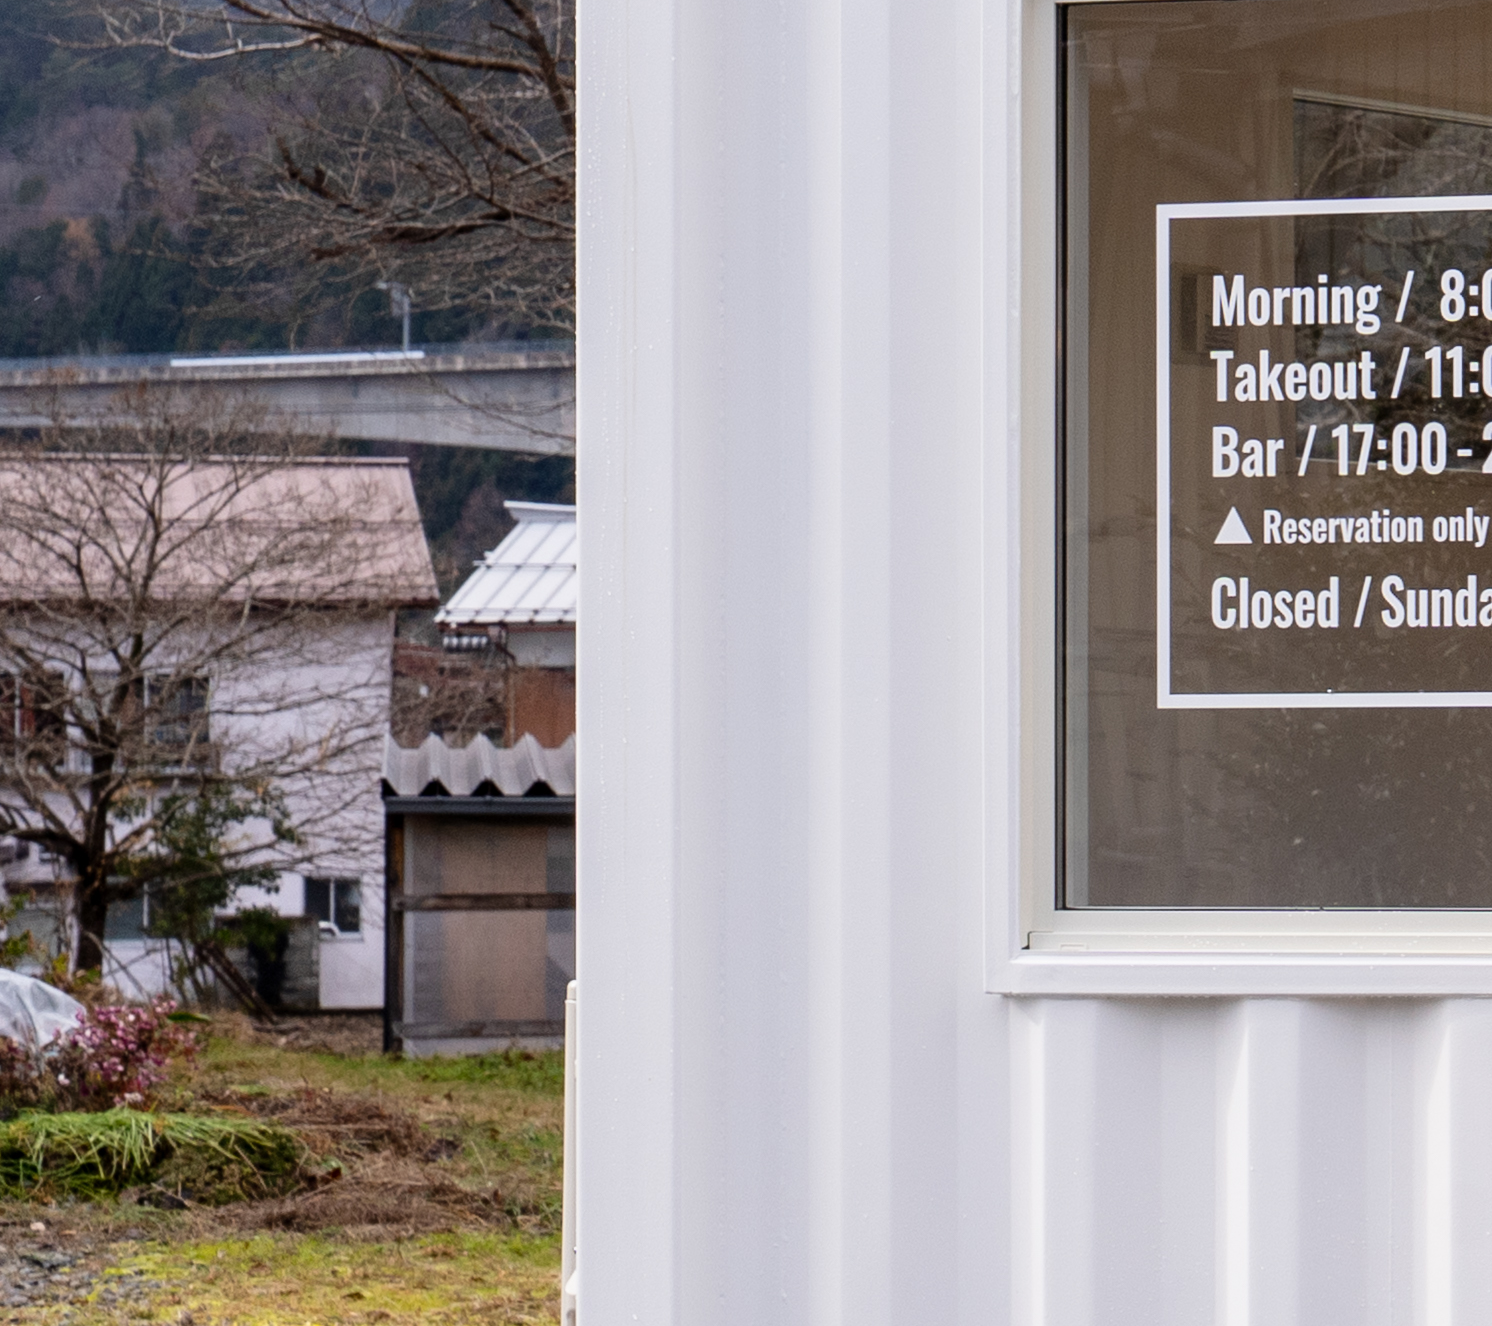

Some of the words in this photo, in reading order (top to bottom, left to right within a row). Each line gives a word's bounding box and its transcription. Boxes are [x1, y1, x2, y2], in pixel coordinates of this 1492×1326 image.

[1211, 273, 1382, 334] Morning
[1209, 349, 1376, 403] Takeout
[1211, 426, 1284, 478] Bar
[1262, 510, 1424, 546] Reservation
[1433, 507, 1490, 550] only
[1210, 576, 1341, 630] Closed
